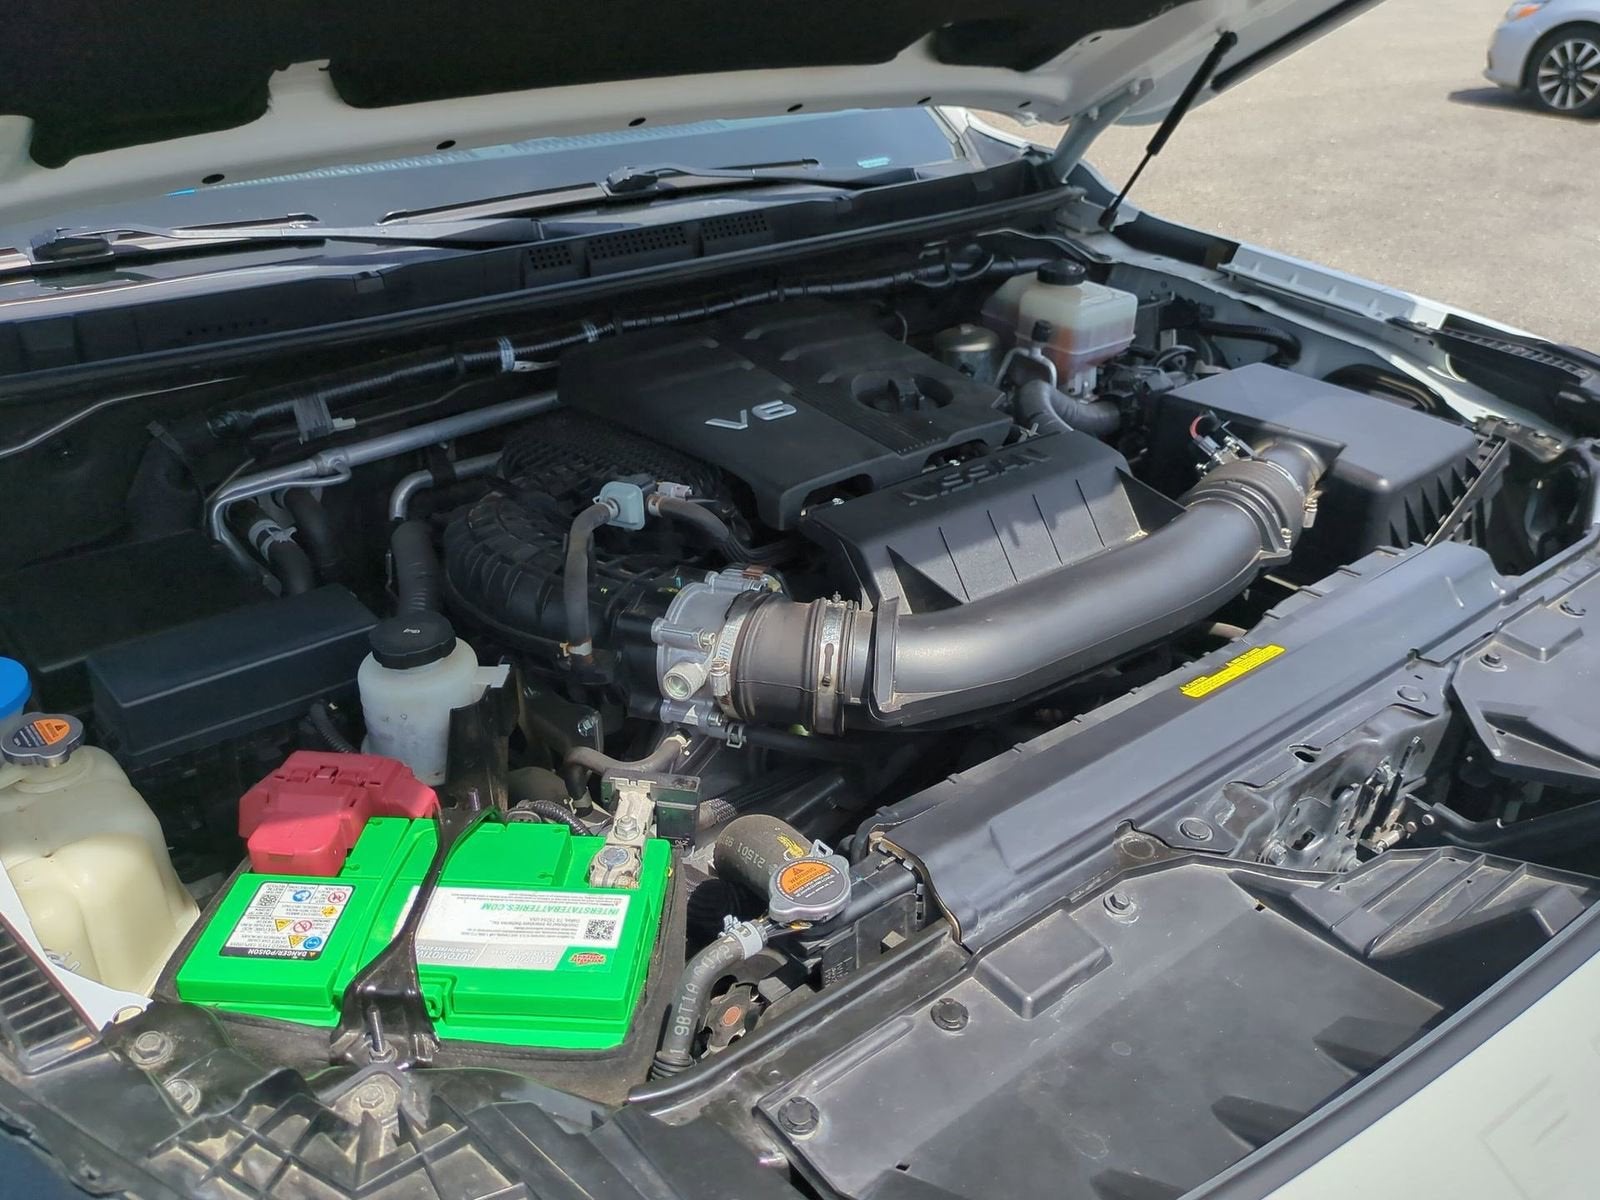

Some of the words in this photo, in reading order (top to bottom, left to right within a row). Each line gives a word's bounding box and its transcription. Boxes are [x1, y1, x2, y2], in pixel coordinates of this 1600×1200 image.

[704, 399, 797, 430] V6
[902, 448, 1052, 507] NISSAN
[737, 842, 766, 869] 21501
[481, 903, 620, 915] INTERSTATEBATTERIES.COM
[248, 948, 307, 958] DANGER/POISON
[415, 949, 474, 960] AUTOMOTIV
[674, 983, 700, 1036] 9BT1A
